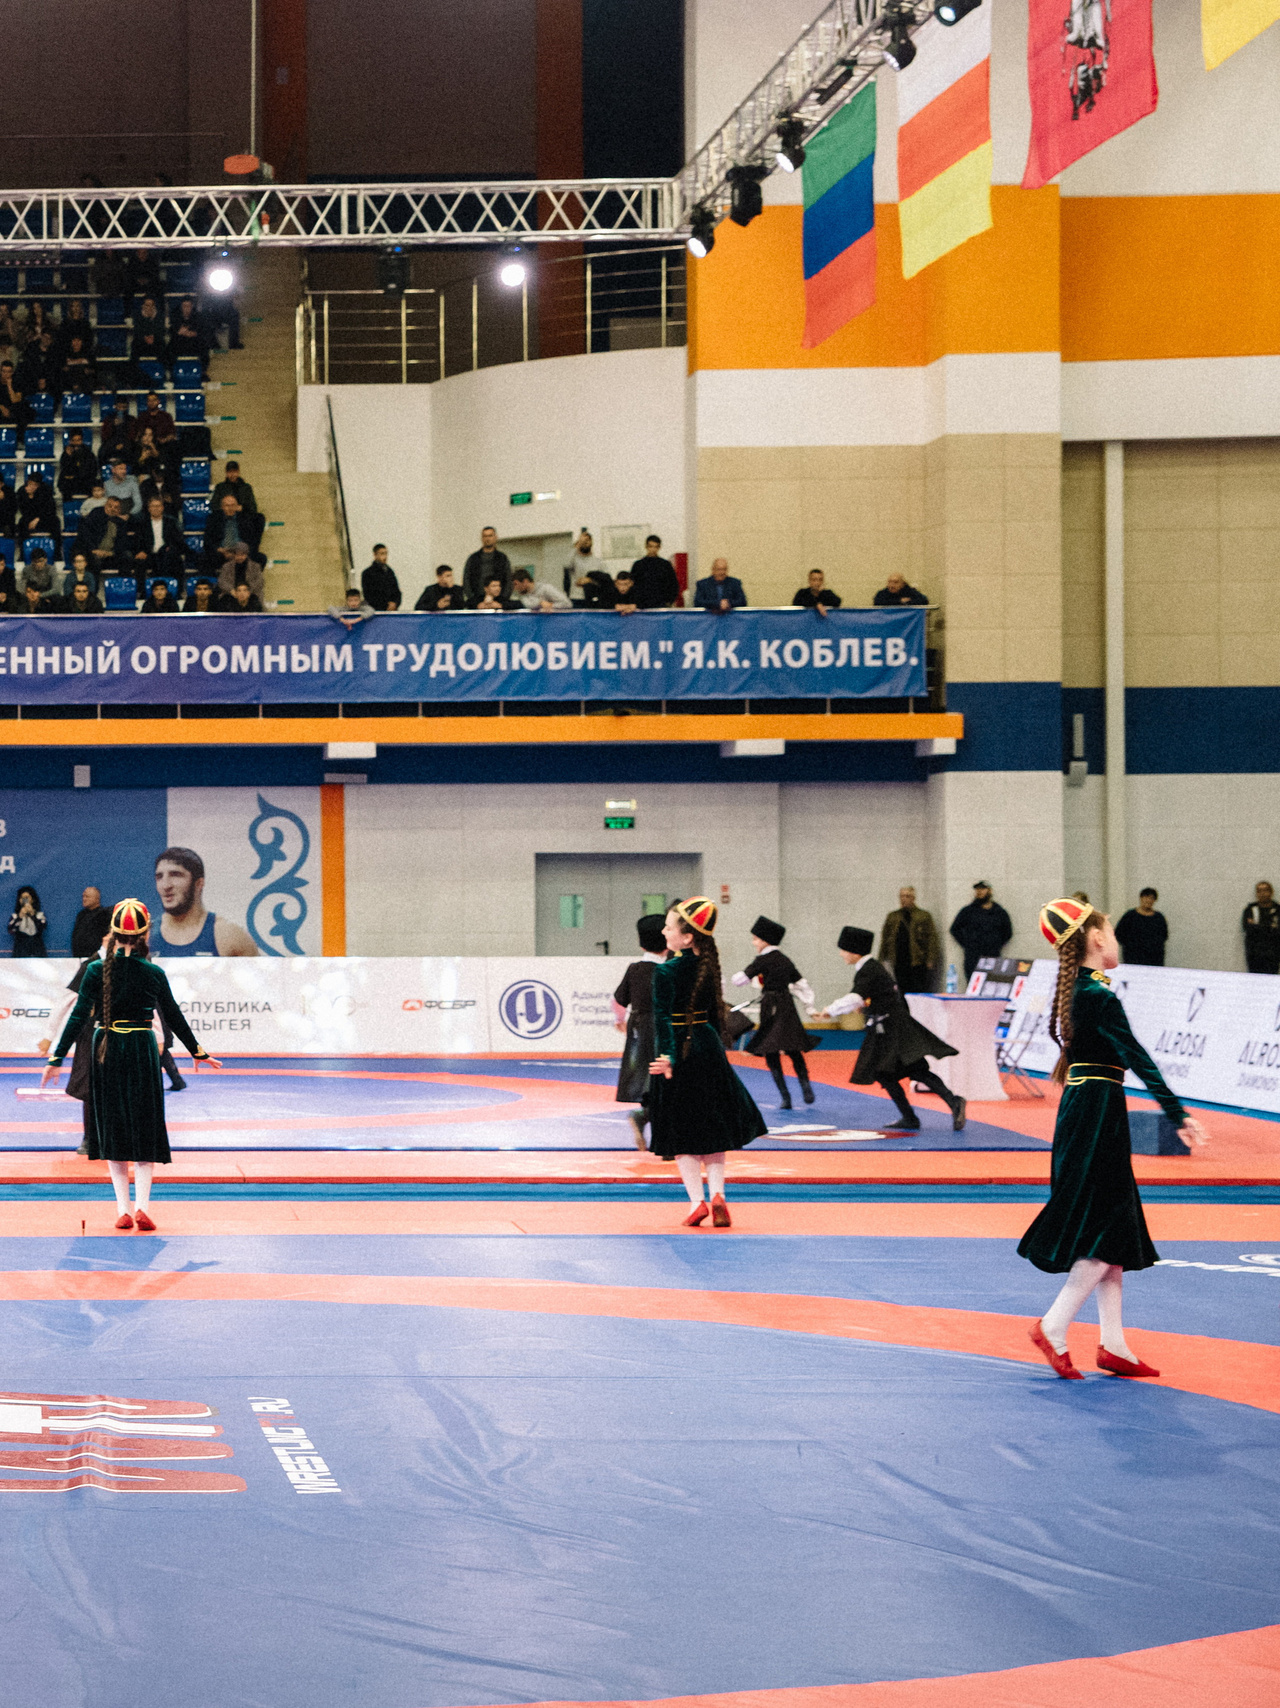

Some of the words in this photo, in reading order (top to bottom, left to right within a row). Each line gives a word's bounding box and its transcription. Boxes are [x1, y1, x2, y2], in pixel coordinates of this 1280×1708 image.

[130, 644, 353, 674] ОГРОМНЫМ
[362, 639, 673, 678] ТРУДОЛЮБИЕМ."
[682, 640, 750, 669] Я.К.
[760, 637, 919, 668] КОБЛЕВ.
[12, 1008, 52, 1018] ФСБ
[179, 1001, 273, 1013] СПУБЛИКА
[191, 1019, 251, 1032] ДЫГЕЯ
[1154, 1030, 1207, 1058] ALROSA
